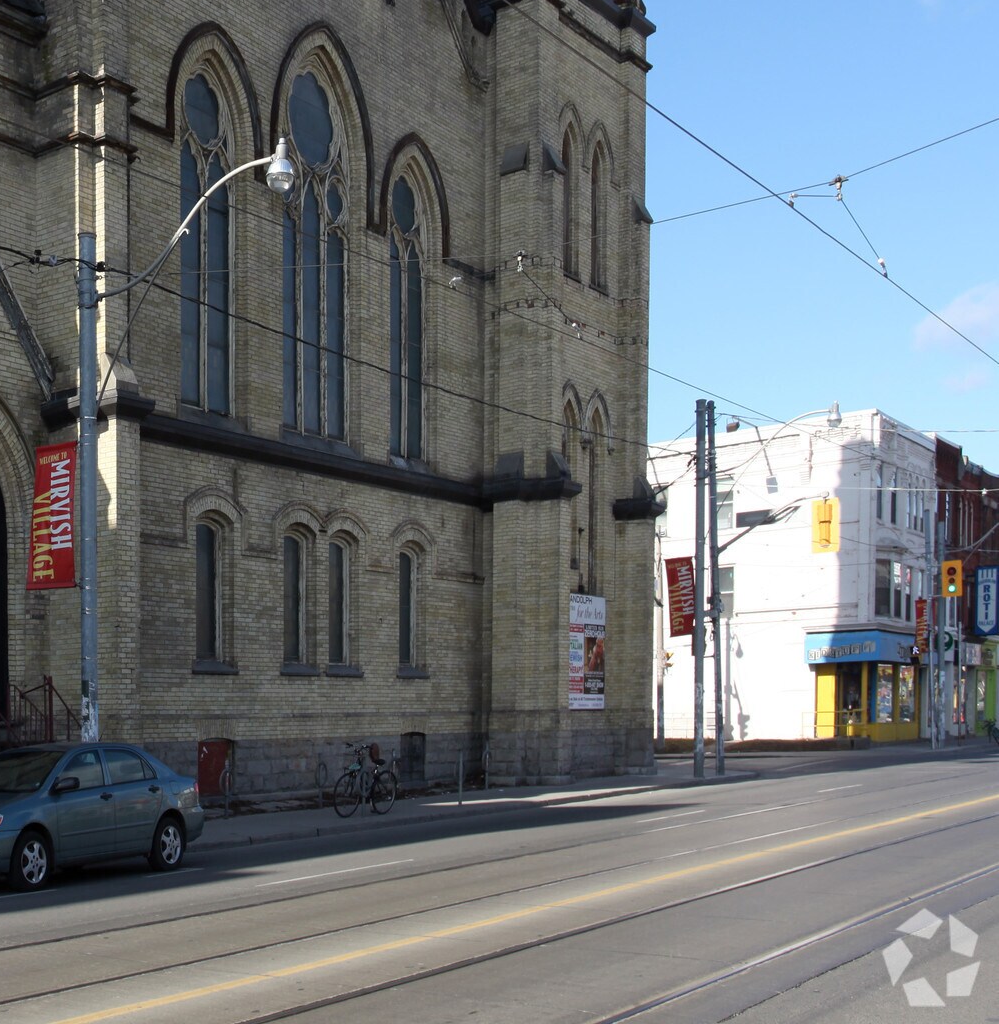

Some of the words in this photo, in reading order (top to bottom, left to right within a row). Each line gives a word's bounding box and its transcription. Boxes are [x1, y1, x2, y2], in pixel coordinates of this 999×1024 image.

[39, 453, 60, 464] WELCOME
[61, 451, 68, 459] TO
[50, 459, 72, 550] MIRVISH
[33, 491, 55, 582] VILLAGE
[570, 595, 593, 605] ANDOLPH
[669, 583, 684, 633] VILLAGE
[677, 565, 694, 615] MIRVISH
[982, 584, 991, 620] ROTI
